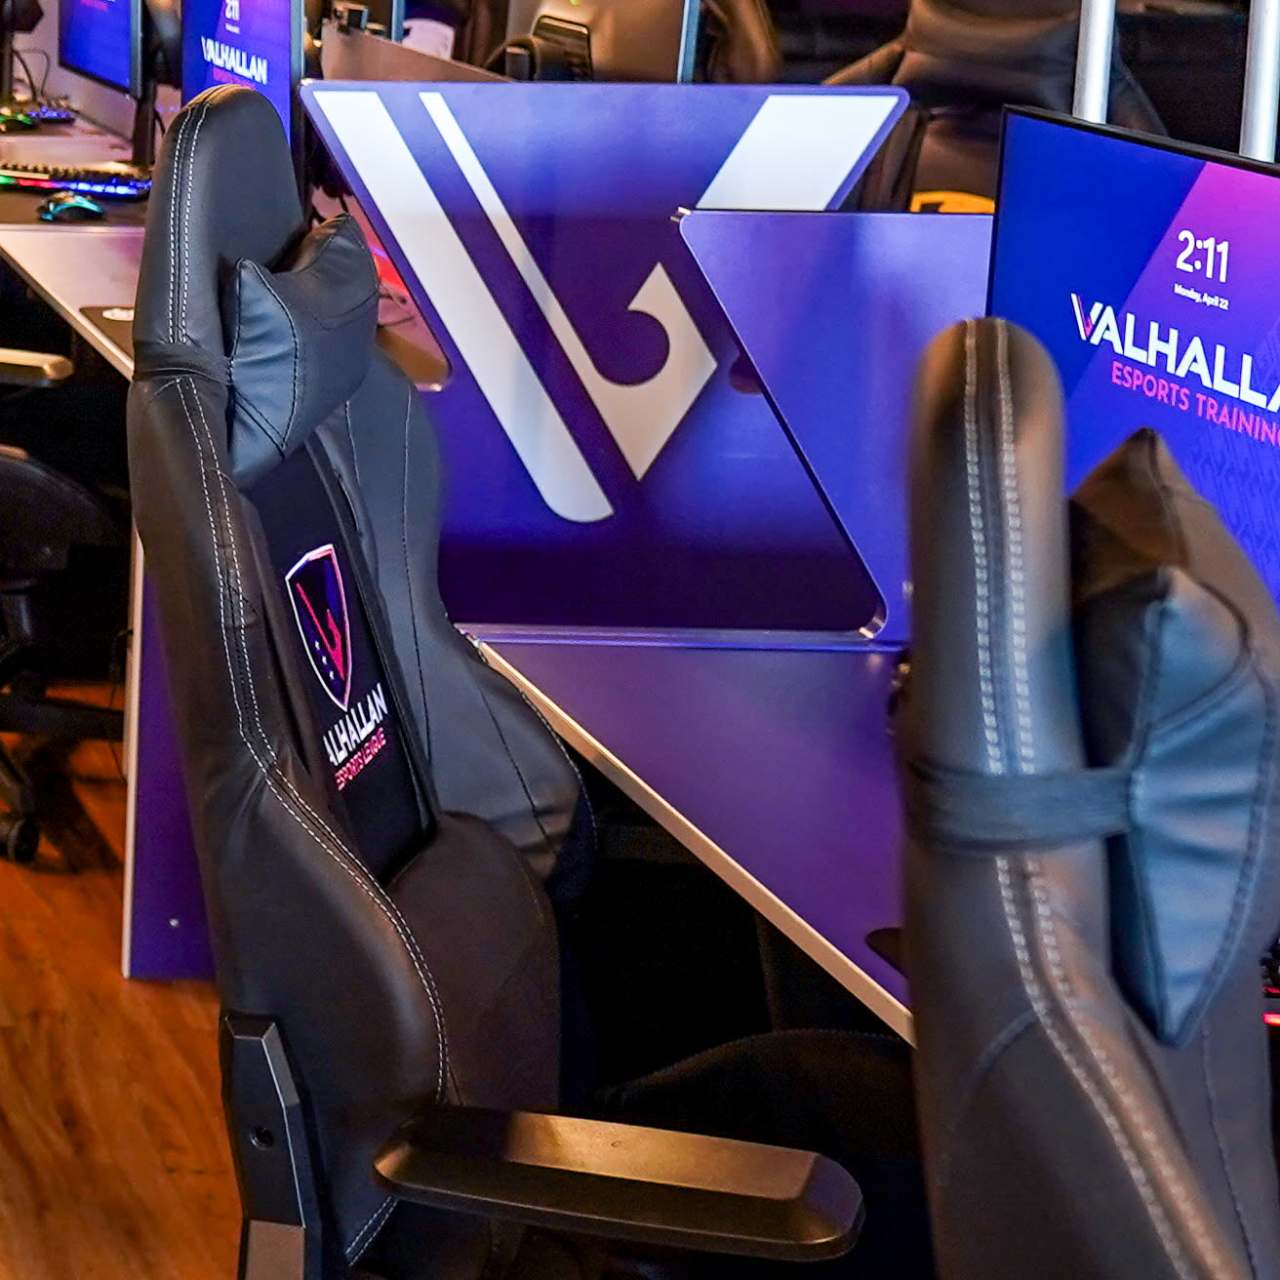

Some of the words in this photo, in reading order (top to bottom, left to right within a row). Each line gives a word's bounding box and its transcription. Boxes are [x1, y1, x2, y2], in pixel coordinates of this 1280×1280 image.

[201, 35, 268, 86] VALHALLAN
[1176, 229, 1230, 283] 2:11
[1111, 360, 1190, 411] ESPORTS
[1195, 392, 1280, 450] TRAININ
[323, 682, 389, 766] ALHALLAN
